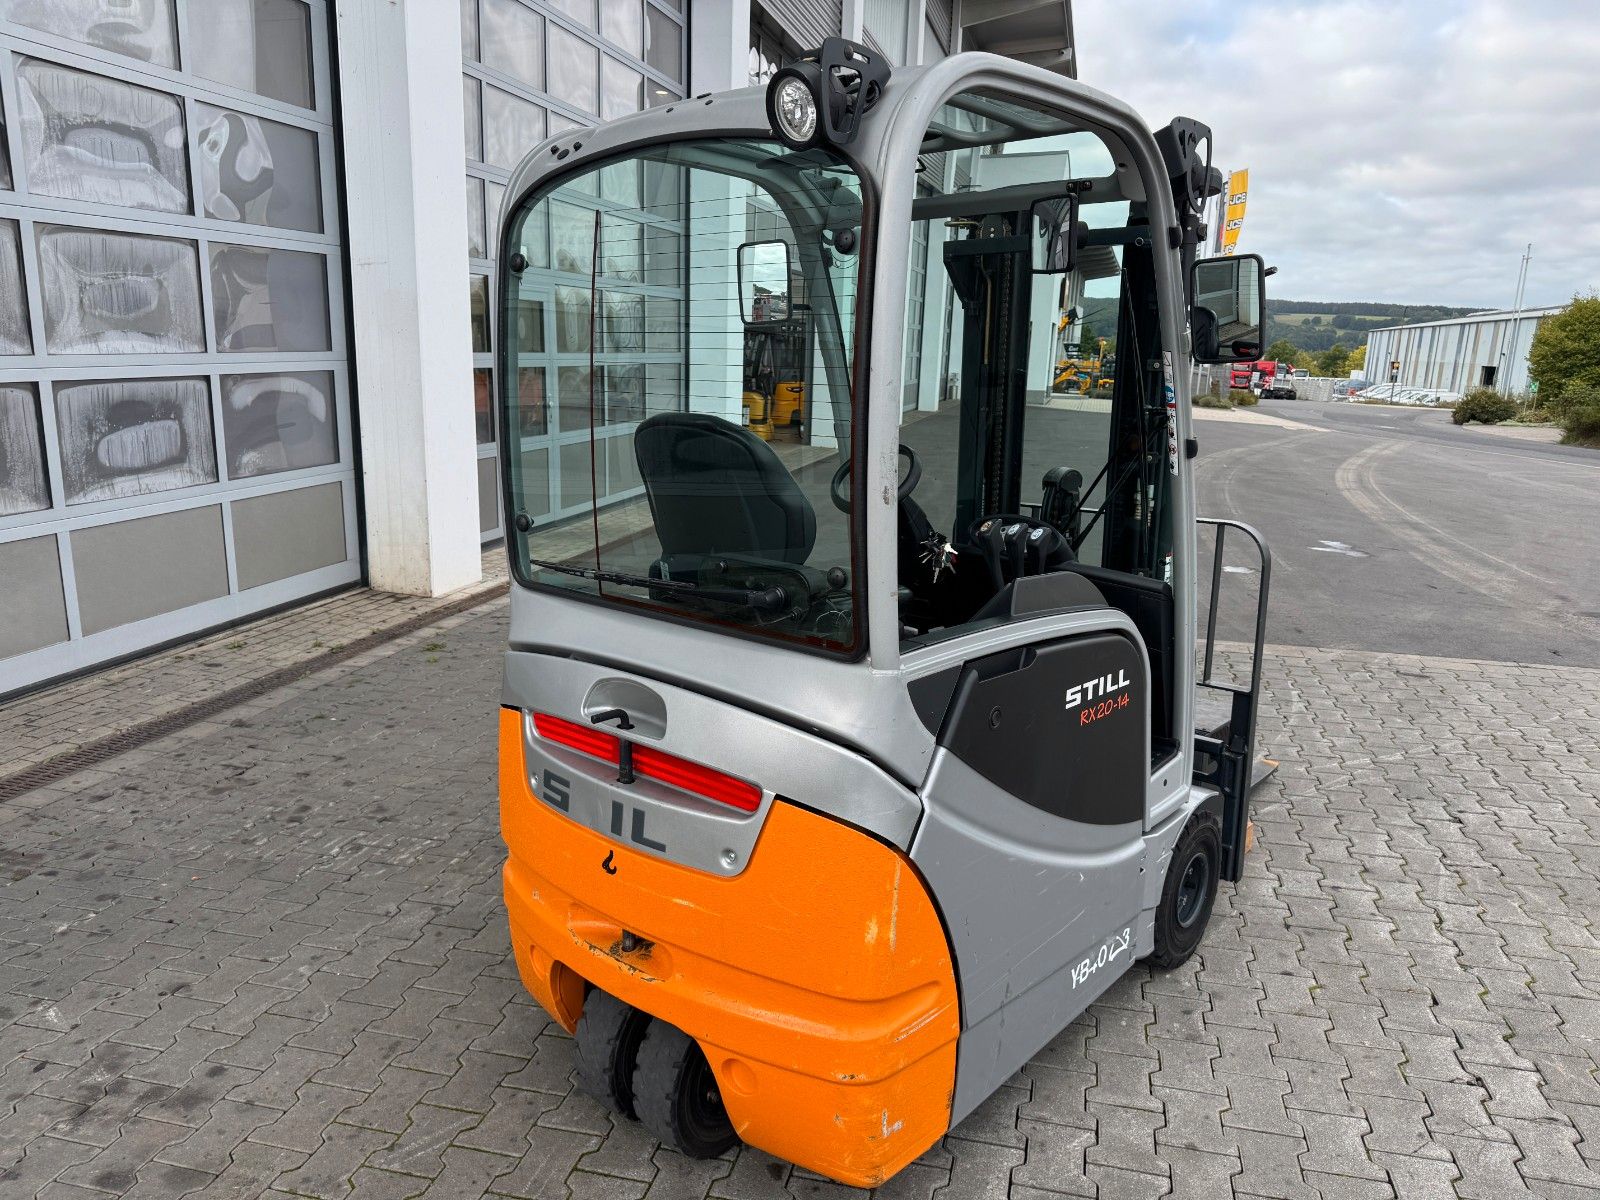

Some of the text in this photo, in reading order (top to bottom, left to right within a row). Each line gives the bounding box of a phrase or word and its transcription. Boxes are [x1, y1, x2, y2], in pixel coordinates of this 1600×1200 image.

[1229, 192, 1247, 205] JCB
[1065, 669, 1130, 710] STILL
[1080, 692, 1130, 726] RX20-14
